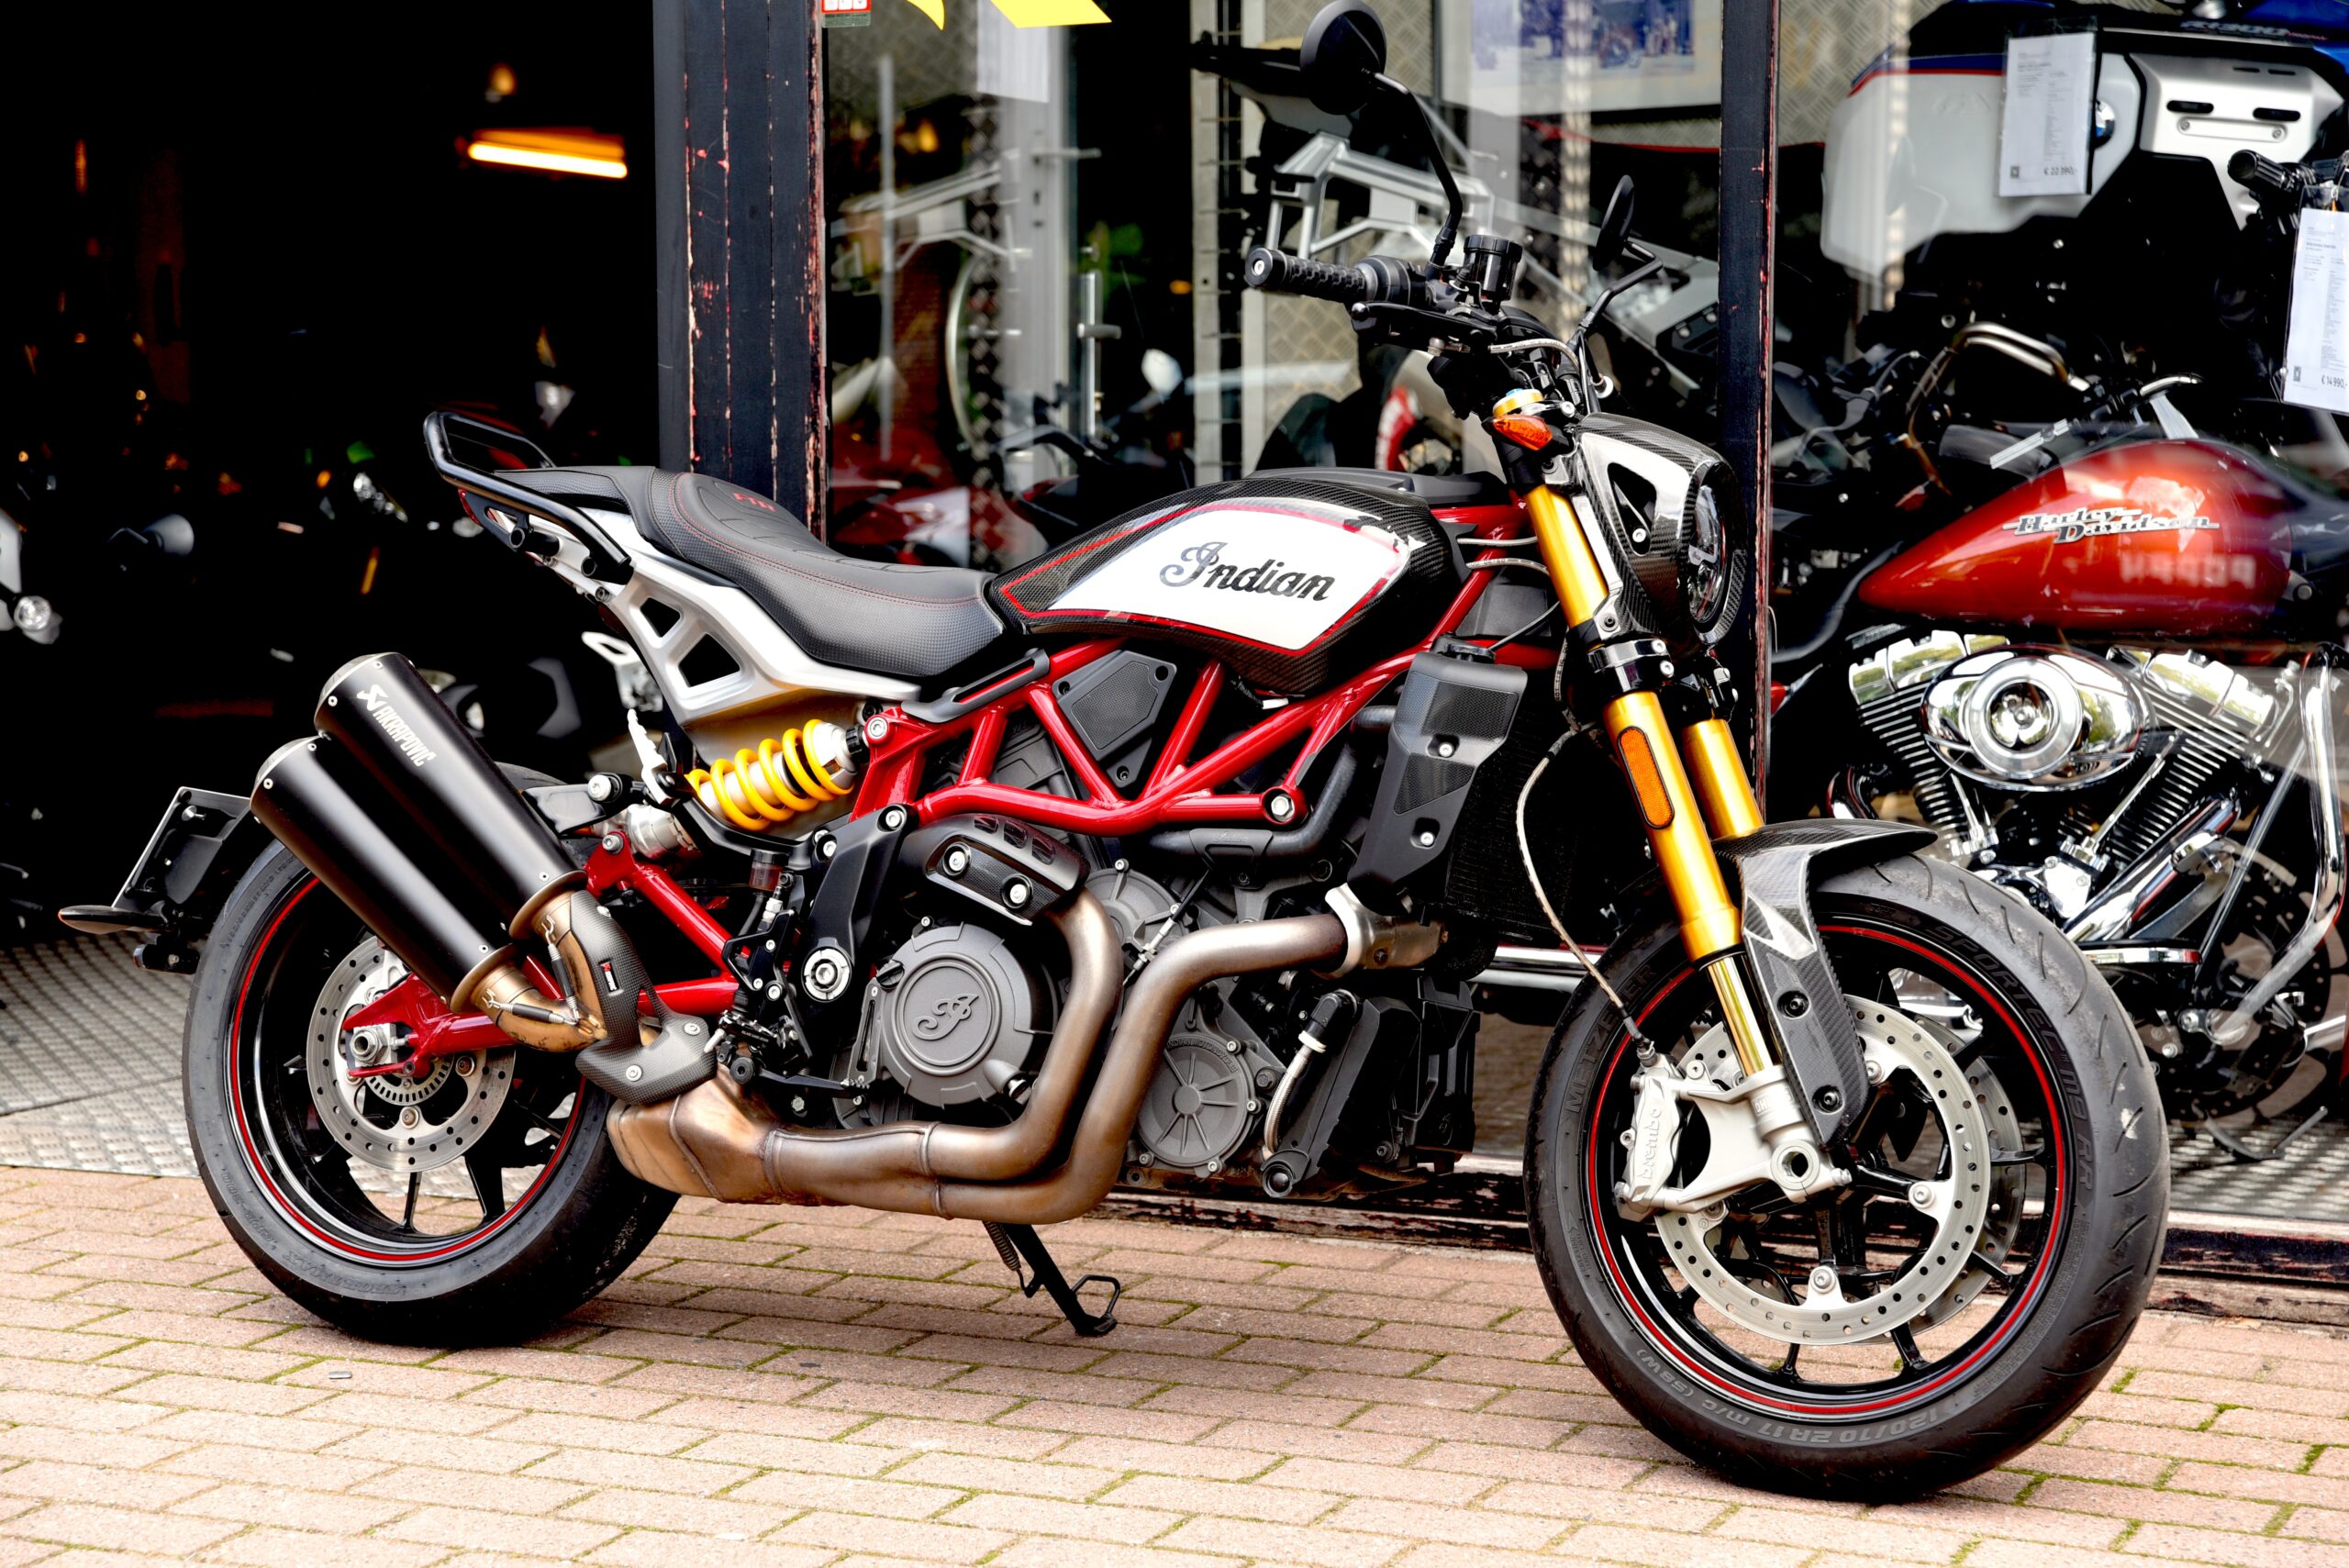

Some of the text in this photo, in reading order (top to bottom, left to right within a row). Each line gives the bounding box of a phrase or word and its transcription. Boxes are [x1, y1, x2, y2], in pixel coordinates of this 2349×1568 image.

[2003, 507, 2142, 535] Harley
[2054, 514, 2220, 544] Davidson
[1159, 541, 1335, 601] Indian
[1564, 964, 1657, 1114] METZEER
[1637, 1108, 1661, 1179] brembo
[1839, 1408, 1938, 1443] 120/70
